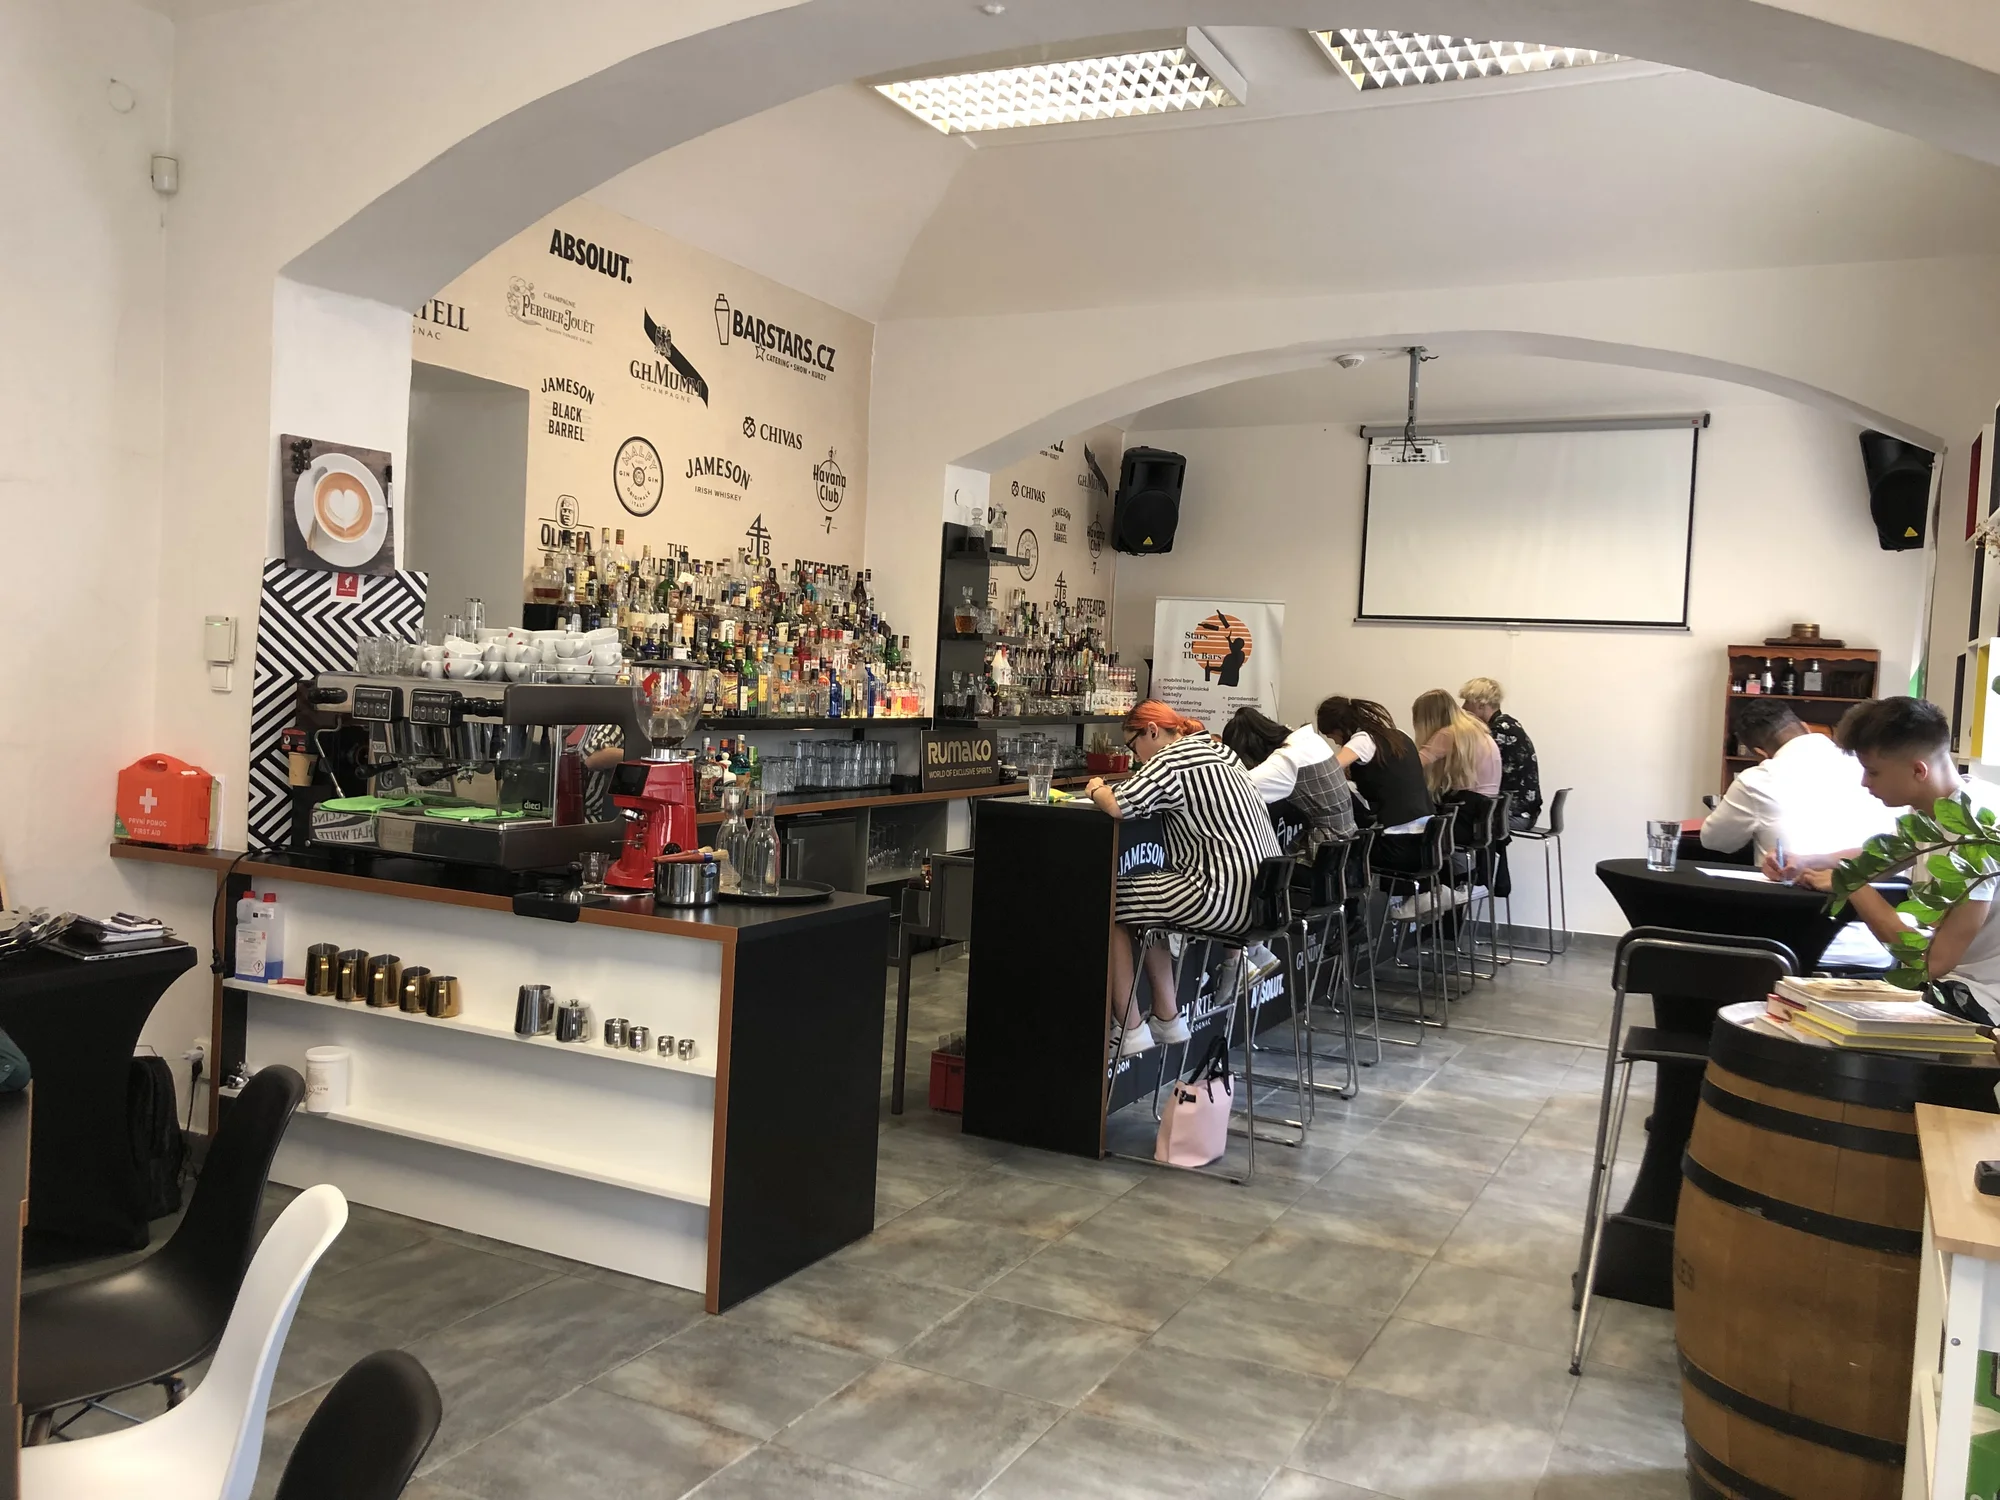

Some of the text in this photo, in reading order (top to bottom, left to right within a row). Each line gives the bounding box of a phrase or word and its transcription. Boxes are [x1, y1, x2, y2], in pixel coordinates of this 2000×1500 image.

[549, 229, 632, 284] ABSOLUT.
[413, 299, 469, 332] TELL
[732, 309, 836, 372] BARSTARS.CZ
[766, 354, 789, 368] CATERING
[793, 364, 807, 374] SHOW
[541, 377, 595, 405] JAMESON
[640, 383, 691, 403] CHAMPAGNE
[552, 401, 582, 422] BLACK
[548, 419, 585, 441] BARREL
[760, 423, 803, 450] CHIVAS
[621, 445, 657, 469] MALFY
[685, 456, 750, 491] JAMESON
[812, 464, 847, 488] Havana
[694, 486, 742, 501] IRISH WHISKEY
[820, 484, 839, 503] Club
[1021, 485, 1046, 503] CHIVAS
[1051, 507, 1072, 522] JAMESON
[541, 523, 592, 551] OLEA
[1184, 641, 1196, 649] Of
[1185, 631, 1208, 640] Stars
[1182, 651, 1222, 660] The Bars
[928, 766, 993, 779] WORLD OF EXCLUSIVE SPIRITS
[133, 827, 161, 836] FIRST AID
[146, 818, 167, 827] POMOC
[1117, 842, 1165, 876] JAMESON
[1250, 973, 1285, 1009] ASOLUT.
